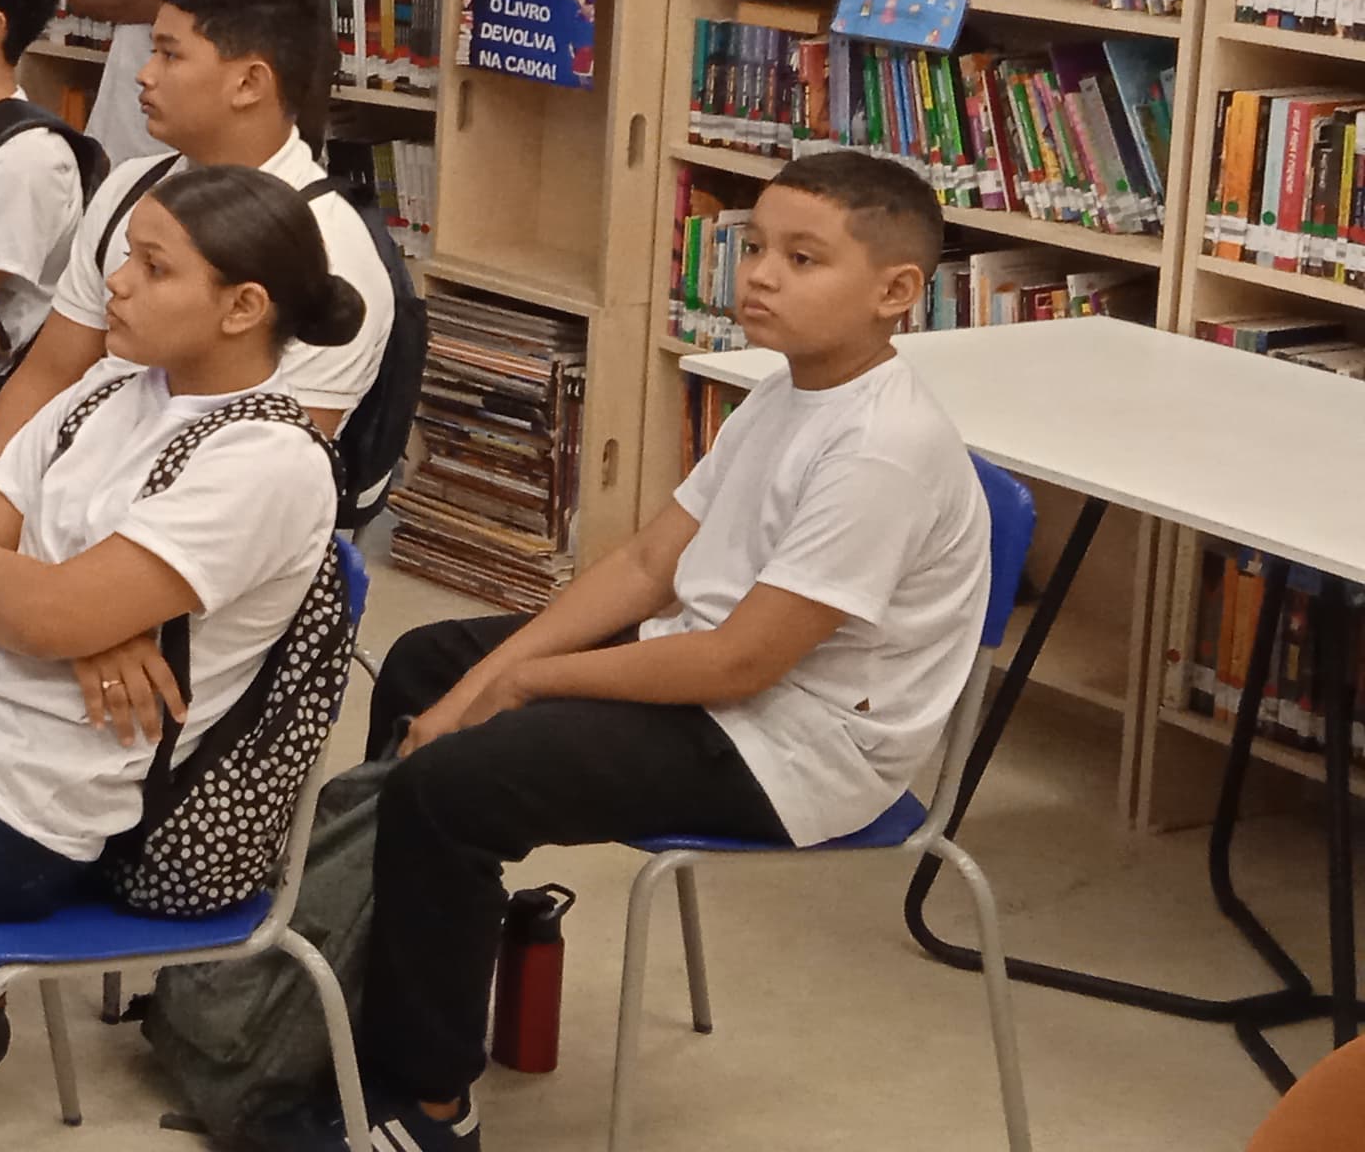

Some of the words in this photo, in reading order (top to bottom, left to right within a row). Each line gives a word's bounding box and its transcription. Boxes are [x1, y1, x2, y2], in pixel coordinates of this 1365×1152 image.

[504, 0, 551, 23] LIVRO
[480, 22, 556, 53] DEVOLVA
[479, 50, 503, 70] NA
[505, 56, 557, 81] CAIXA!
